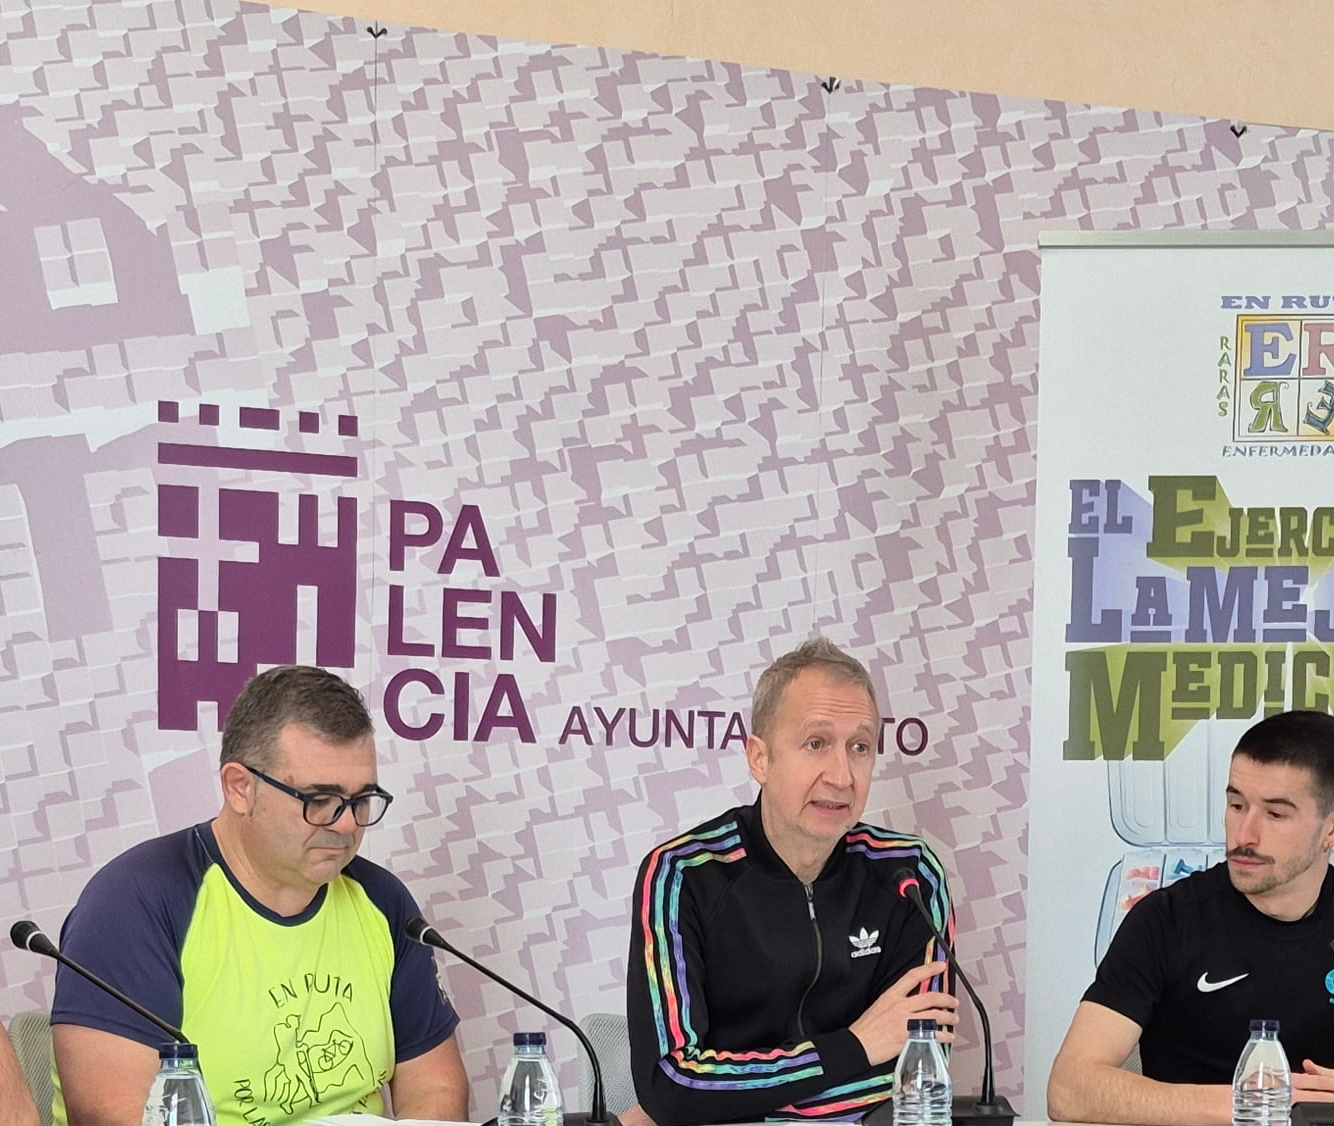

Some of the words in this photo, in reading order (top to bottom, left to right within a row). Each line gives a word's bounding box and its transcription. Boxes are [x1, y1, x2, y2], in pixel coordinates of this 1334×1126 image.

[1221, 295, 1271, 309] EN
[1217, 336, 1232, 417] RARAS
[388, 499, 502, 578] PA
[1068, 478, 1134, 535] EL
[387, 584, 557, 663] LEN
[1065, 536, 1173, 644] LA
[381, 667, 537, 744] CIA
[269, 979, 298, 1009] EN
[304, 973, 353, 1002] RUTA
